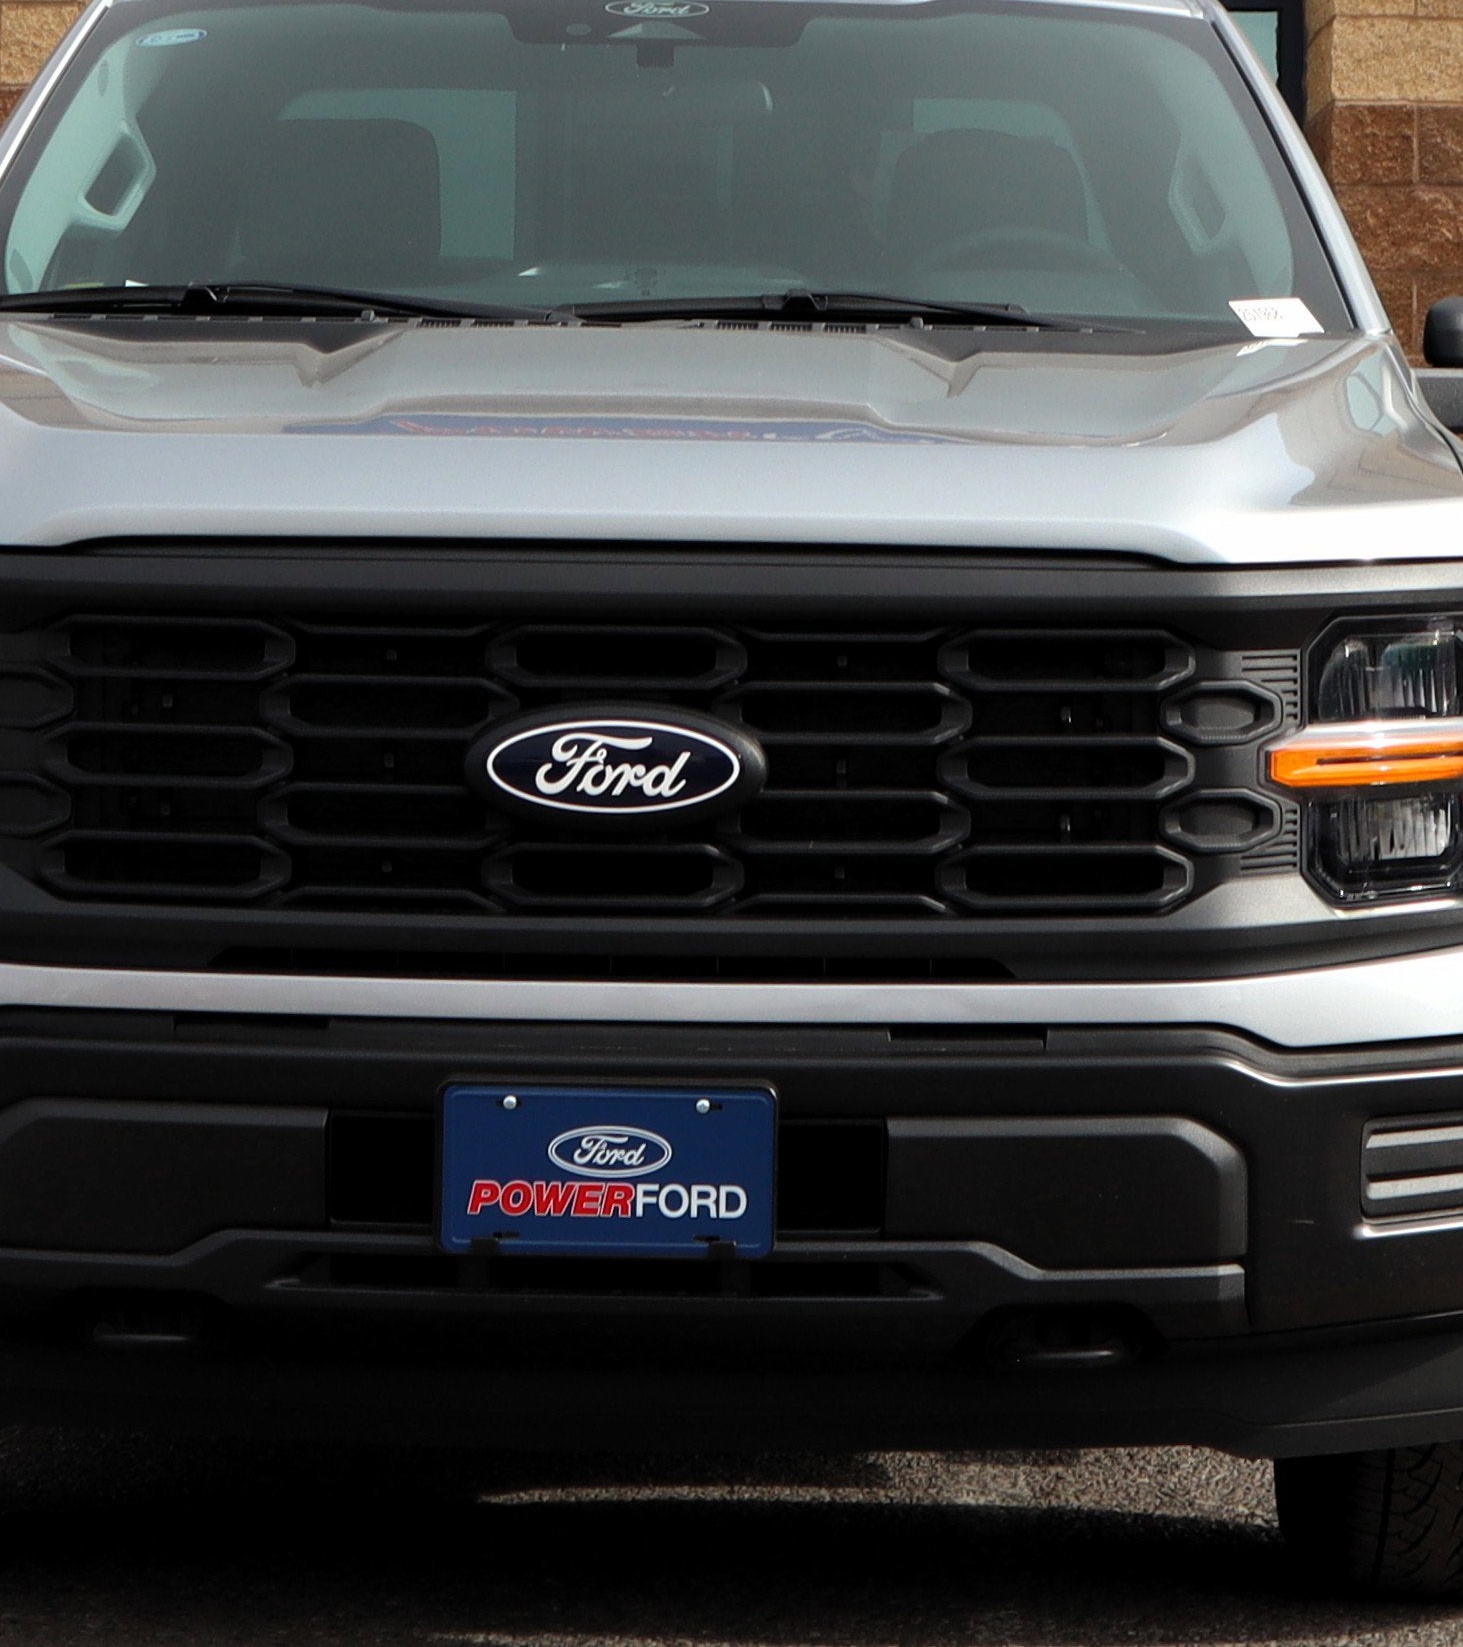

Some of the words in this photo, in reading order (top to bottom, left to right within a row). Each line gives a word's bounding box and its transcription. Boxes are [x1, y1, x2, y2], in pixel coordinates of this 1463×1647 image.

[623, 0, 691, 15] Ford
[535, 732, 691, 798] Ford
[572, 1134, 646, 1167] Ford
[466, 1179, 748, 1219] POWERFORD
